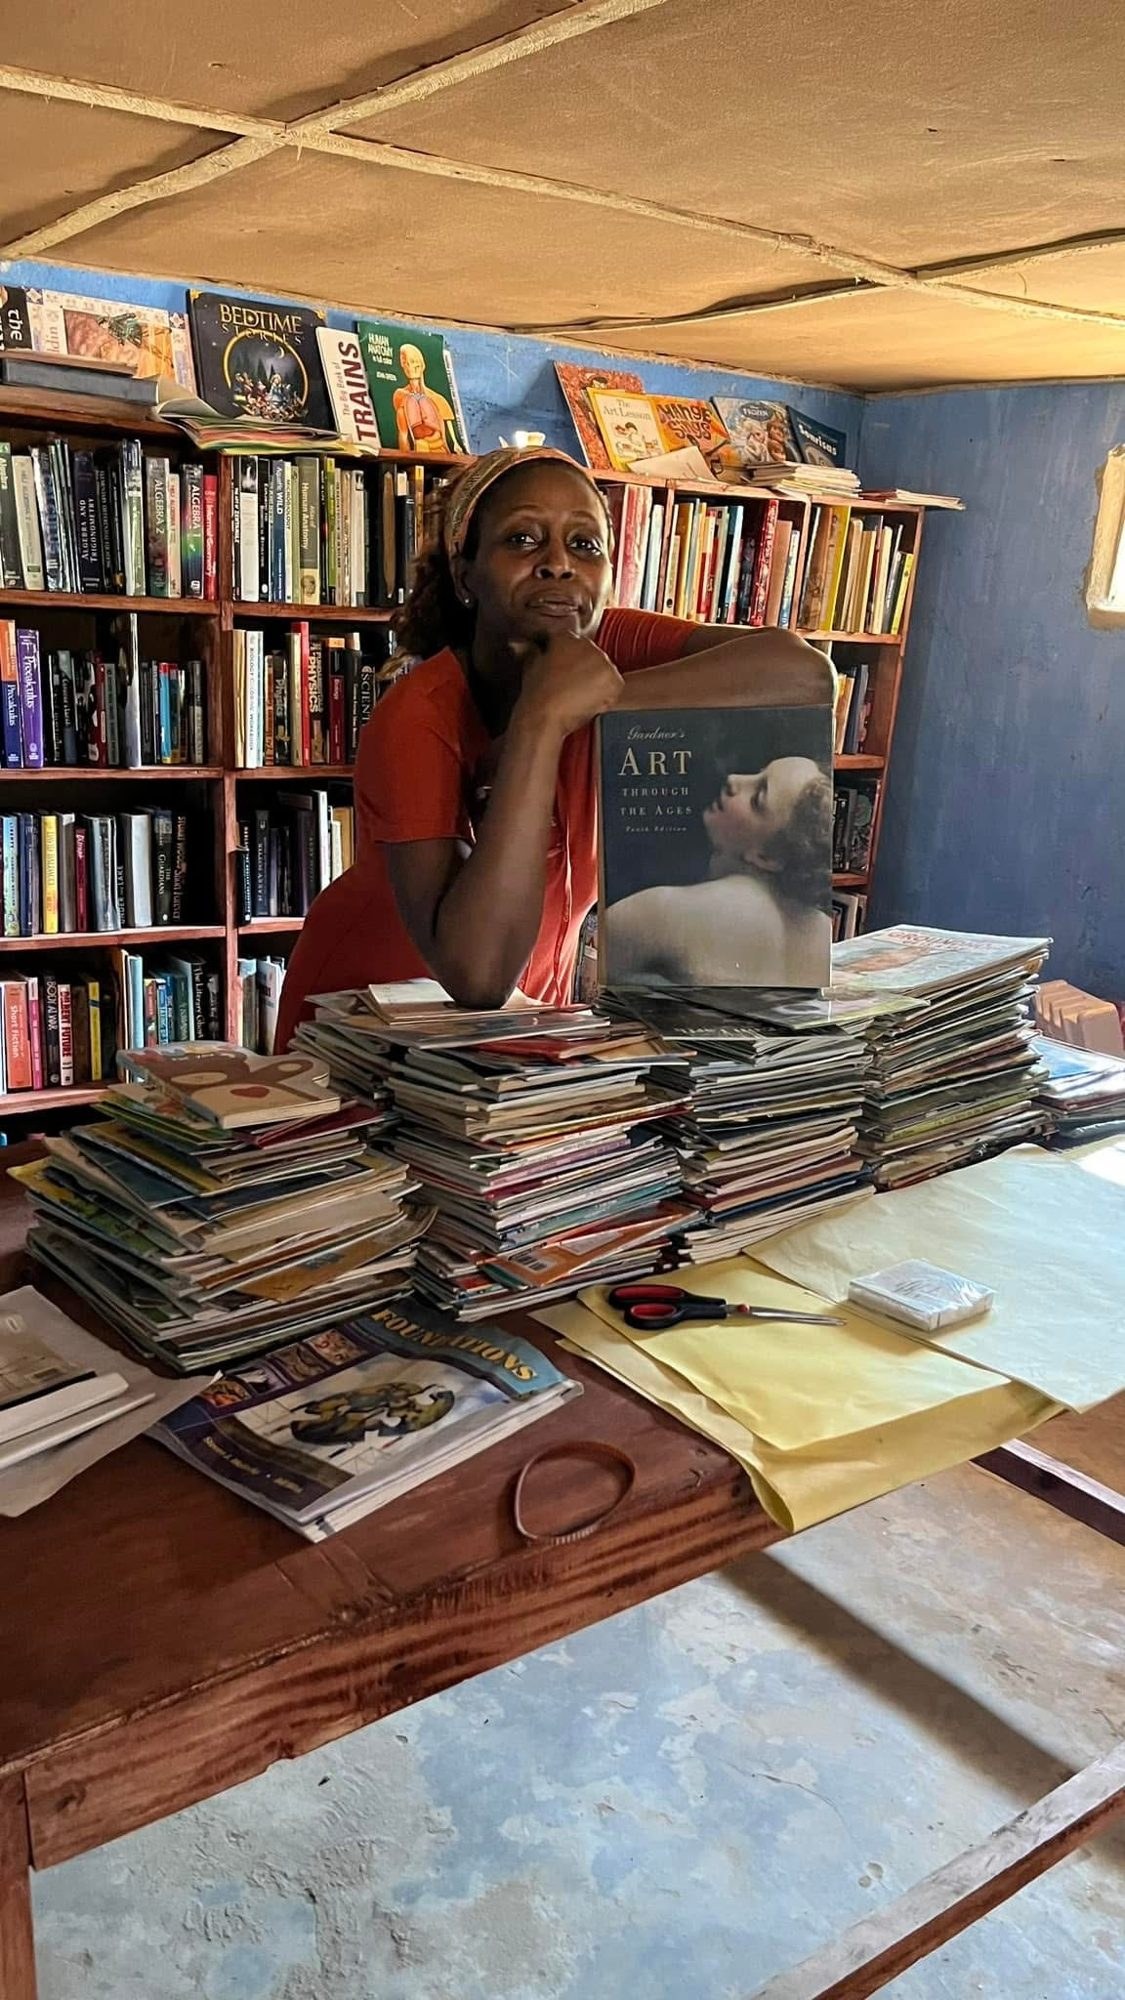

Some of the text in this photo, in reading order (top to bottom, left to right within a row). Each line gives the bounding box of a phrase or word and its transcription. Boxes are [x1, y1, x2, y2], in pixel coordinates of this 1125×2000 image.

[8, 309, 24, 341] the
[219, 303, 304, 335] BEDTIME
[221, 323, 302, 345] STORIES
[368, 332, 390, 347] HUMAN
[338, 341, 377, 441] TRAINS
[603, 405, 652, 420] Art Lesson
[154, 479, 165, 525] ALGEBRA
[191, 484, 201, 530] ALGEBRA
[276, 491, 284, 515] WILD
[299, 483, 310, 549] Human Anatomy
[80, 522, 89, 560] ALGEBRA
[88, 498, 98, 563] TRIGONOMETRY
[205, 504, 214, 577] Informal Geometry
[23, 655, 38, 708] Precalculus
[274, 678, 285, 717] Physics
[308, 656, 318, 713] PHYSICS
[8, 684, 19, 727] Precalculus
[626, 724, 686, 741] Gardner's
[617, 747, 693, 776] ART
[622, 787, 689, 797] THROUGH
[620, 806, 693, 816] THE AGES
[46, 832, 55, 852] DAVID
[177, 816, 187, 869] STUART WOODS
[47, 854, 56, 886] BALDACCI
[117, 896, 125, 925] UNDER
[46, 981, 57, 1004] BODY
[193, 967, 205, 1039] The Literary Ghost
[10, 1005, 20, 1058] Short Fiction
[47, 1014, 57, 1031] WAR
[61, 1025, 72, 1057] FUTURE
